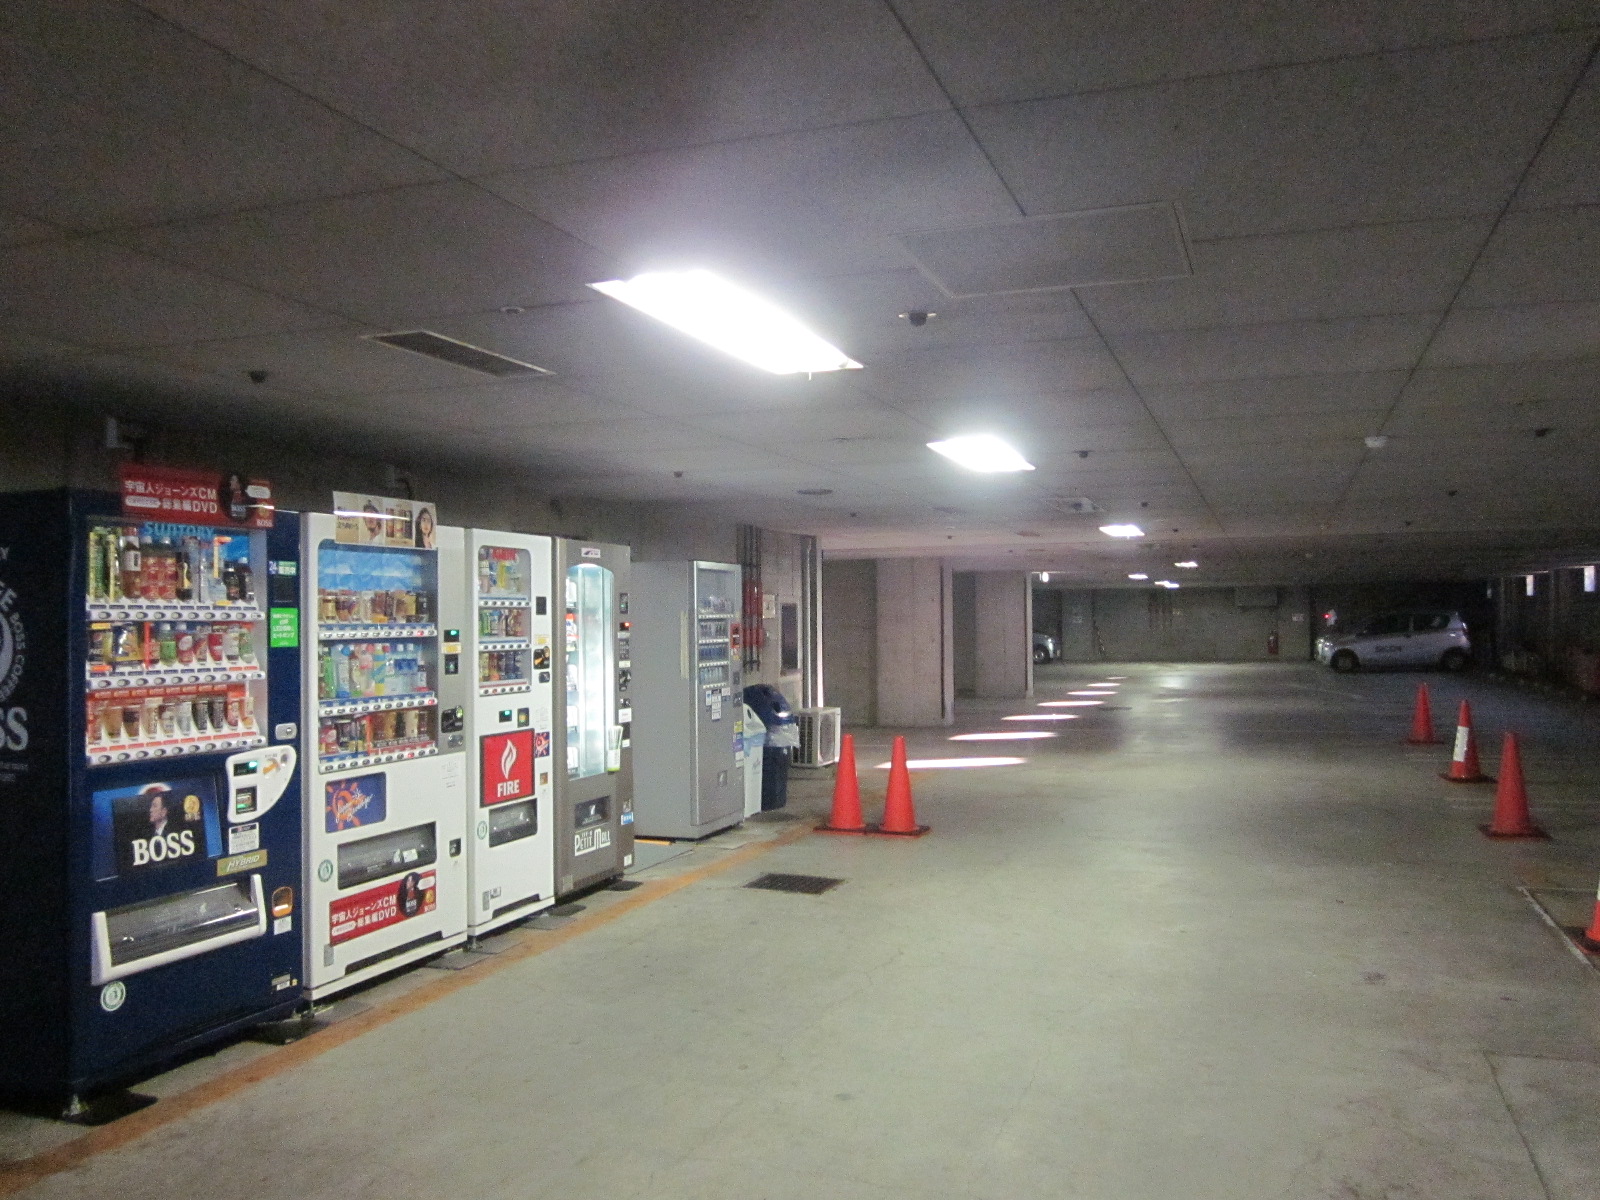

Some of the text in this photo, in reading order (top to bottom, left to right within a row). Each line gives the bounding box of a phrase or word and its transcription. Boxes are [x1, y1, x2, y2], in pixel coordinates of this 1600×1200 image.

[497, 779, 520, 798] FIRE
[131, 830, 195, 866] BOSS
[226, 854, 260, 873] HYBRID
